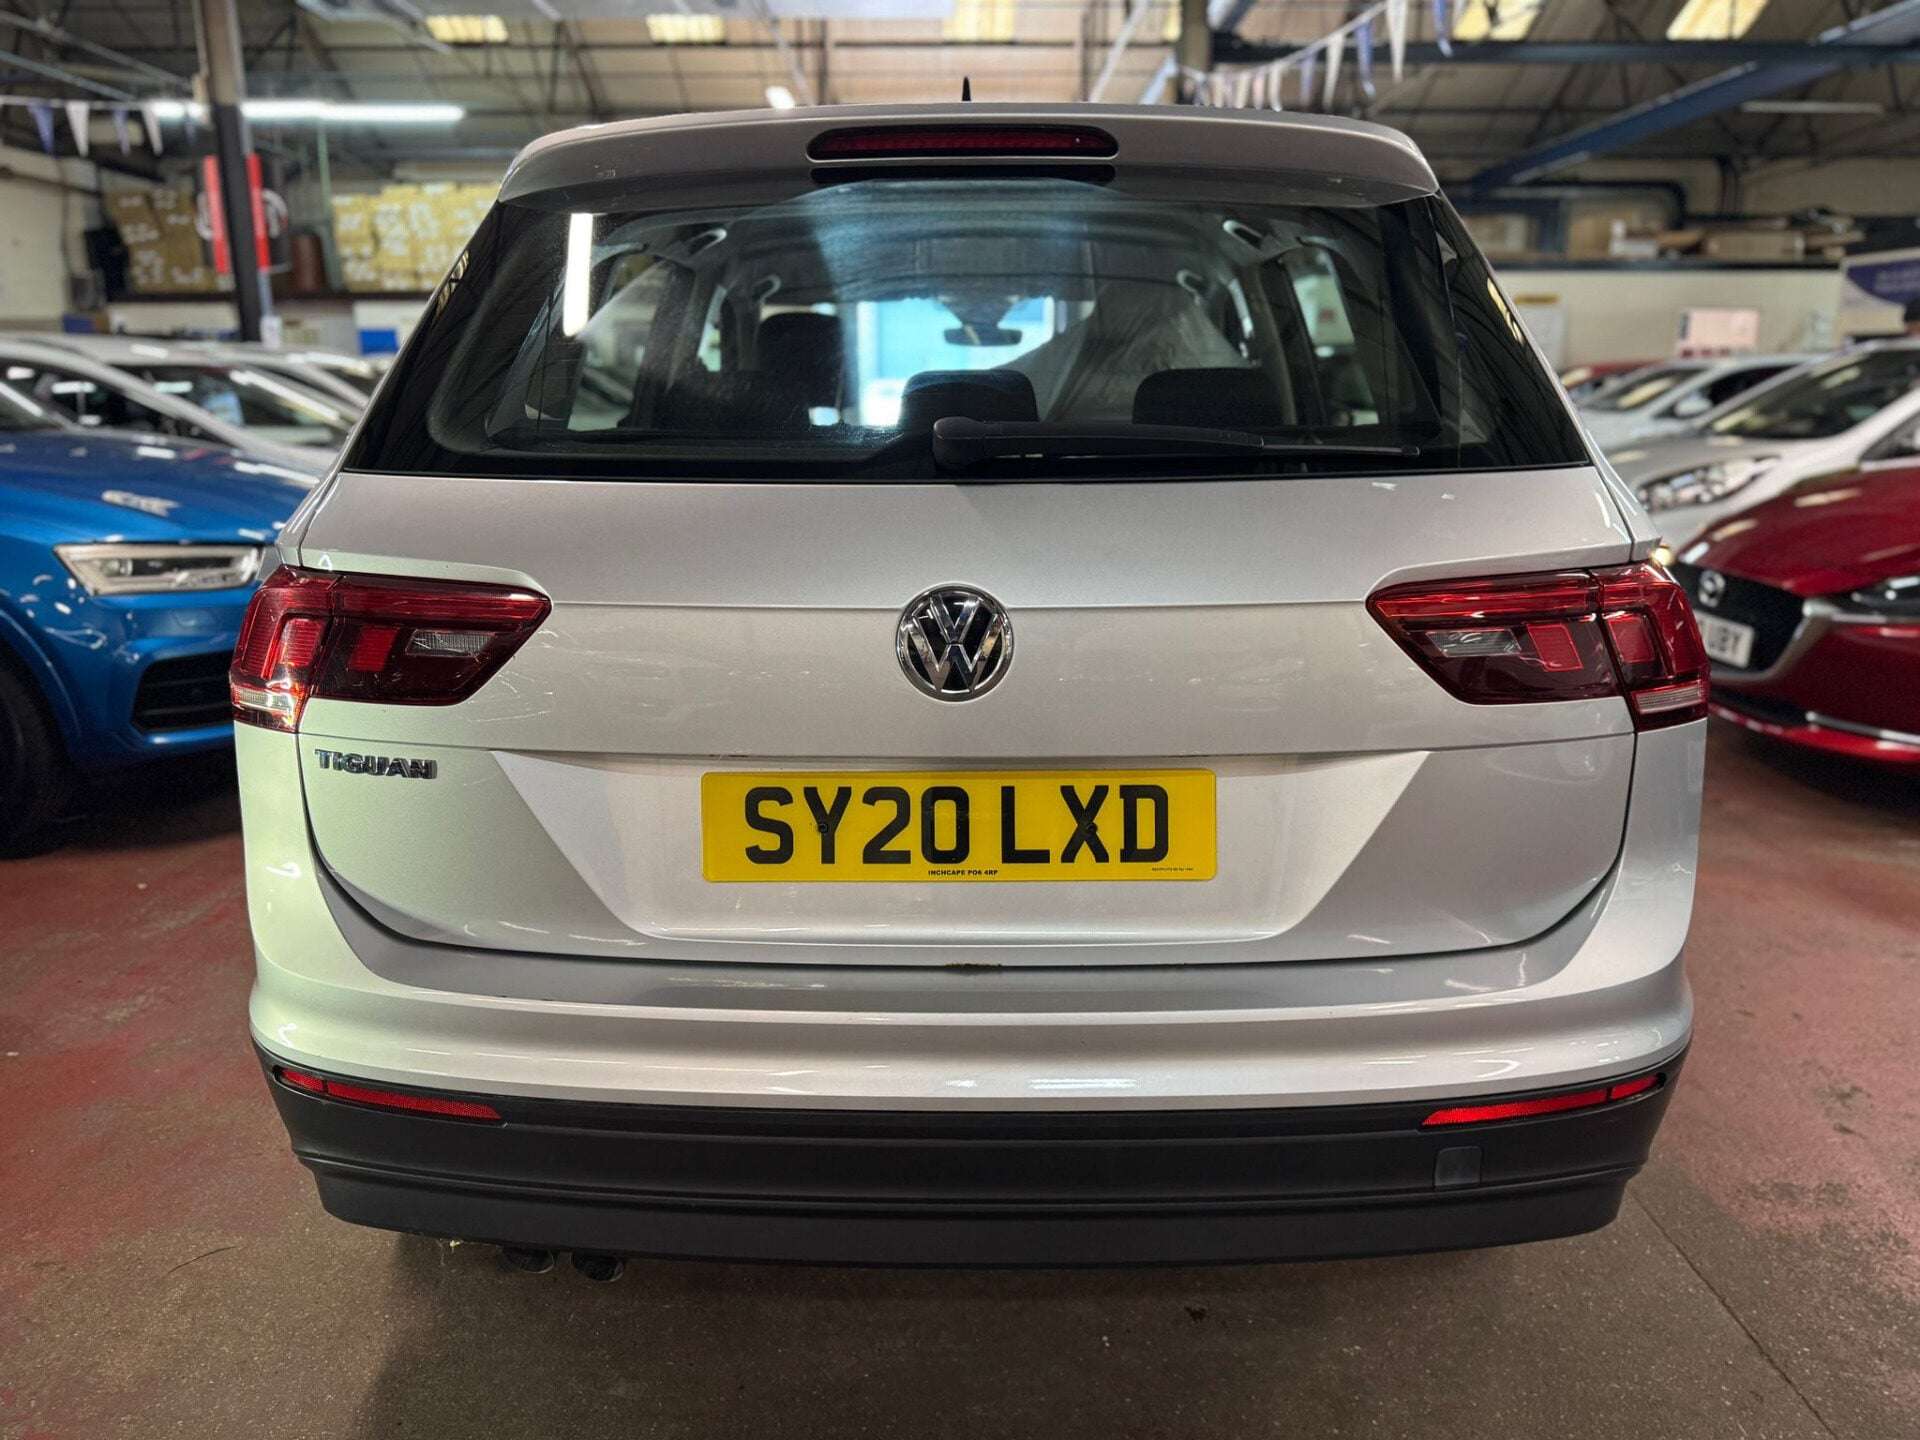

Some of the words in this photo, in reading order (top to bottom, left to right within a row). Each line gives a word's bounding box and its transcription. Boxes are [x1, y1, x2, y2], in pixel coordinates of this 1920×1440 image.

[901, 587, 1009, 698] VW
[314, 748, 438, 780] TIGUAN
[745, 786, 970, 865] SY20
[1001, 784, 1169, 864] LXD
